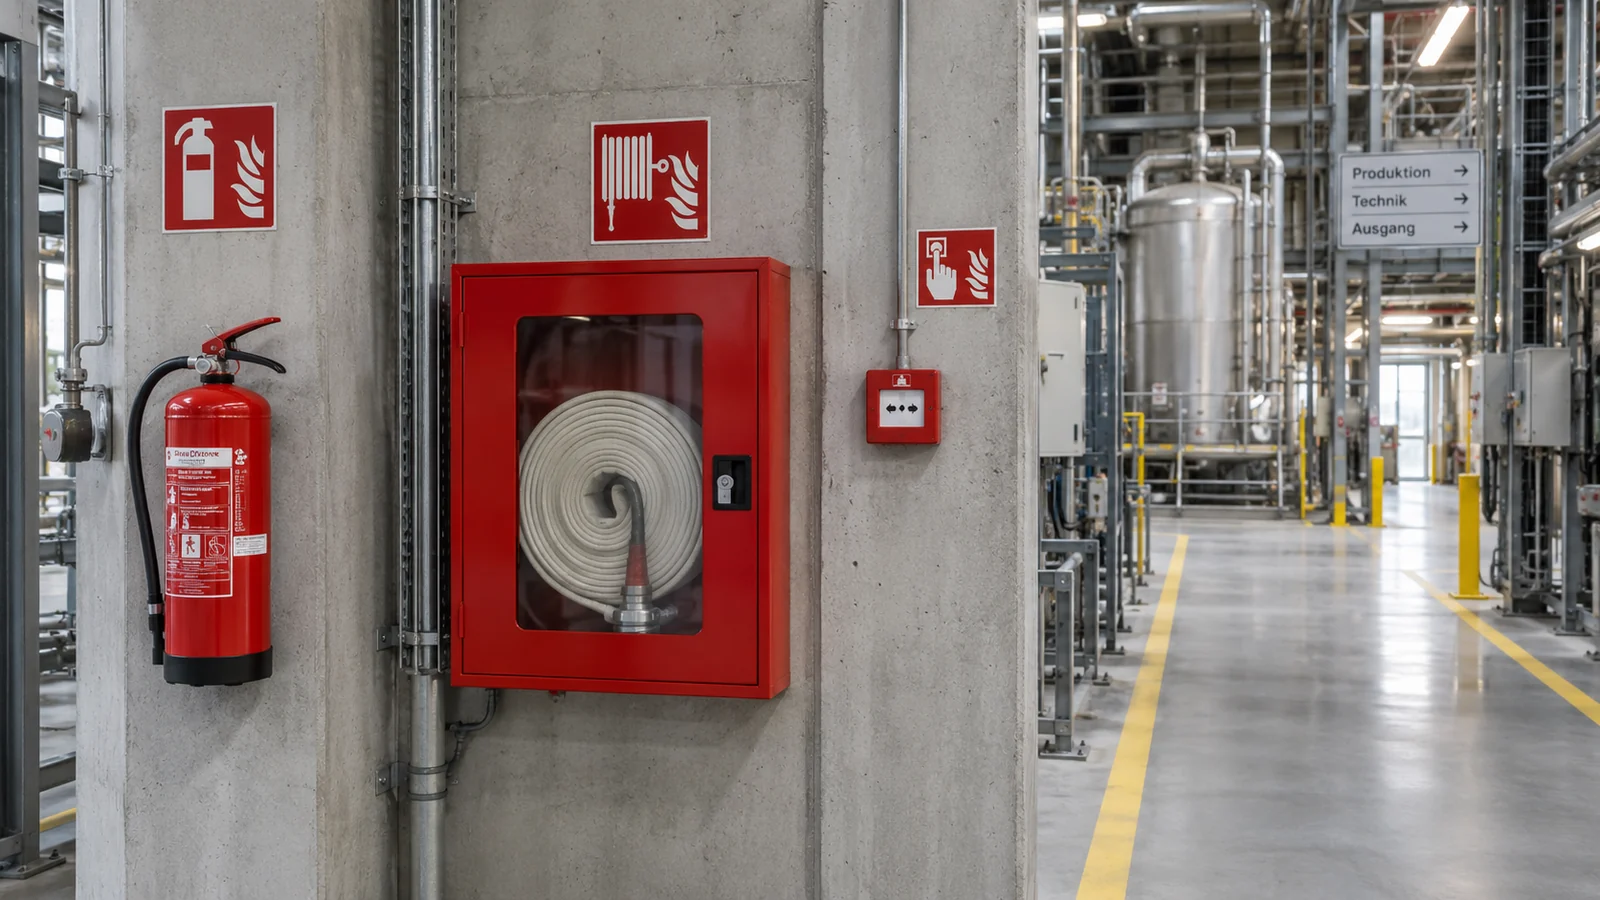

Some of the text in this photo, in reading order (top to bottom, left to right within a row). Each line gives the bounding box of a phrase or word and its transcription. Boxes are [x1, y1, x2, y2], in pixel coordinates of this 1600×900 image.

[1352, 166, 1431, 179] Produktion
[1352, 194, 1407, 207] Technik
[1352, 222, 1415, 237] Ausgang
